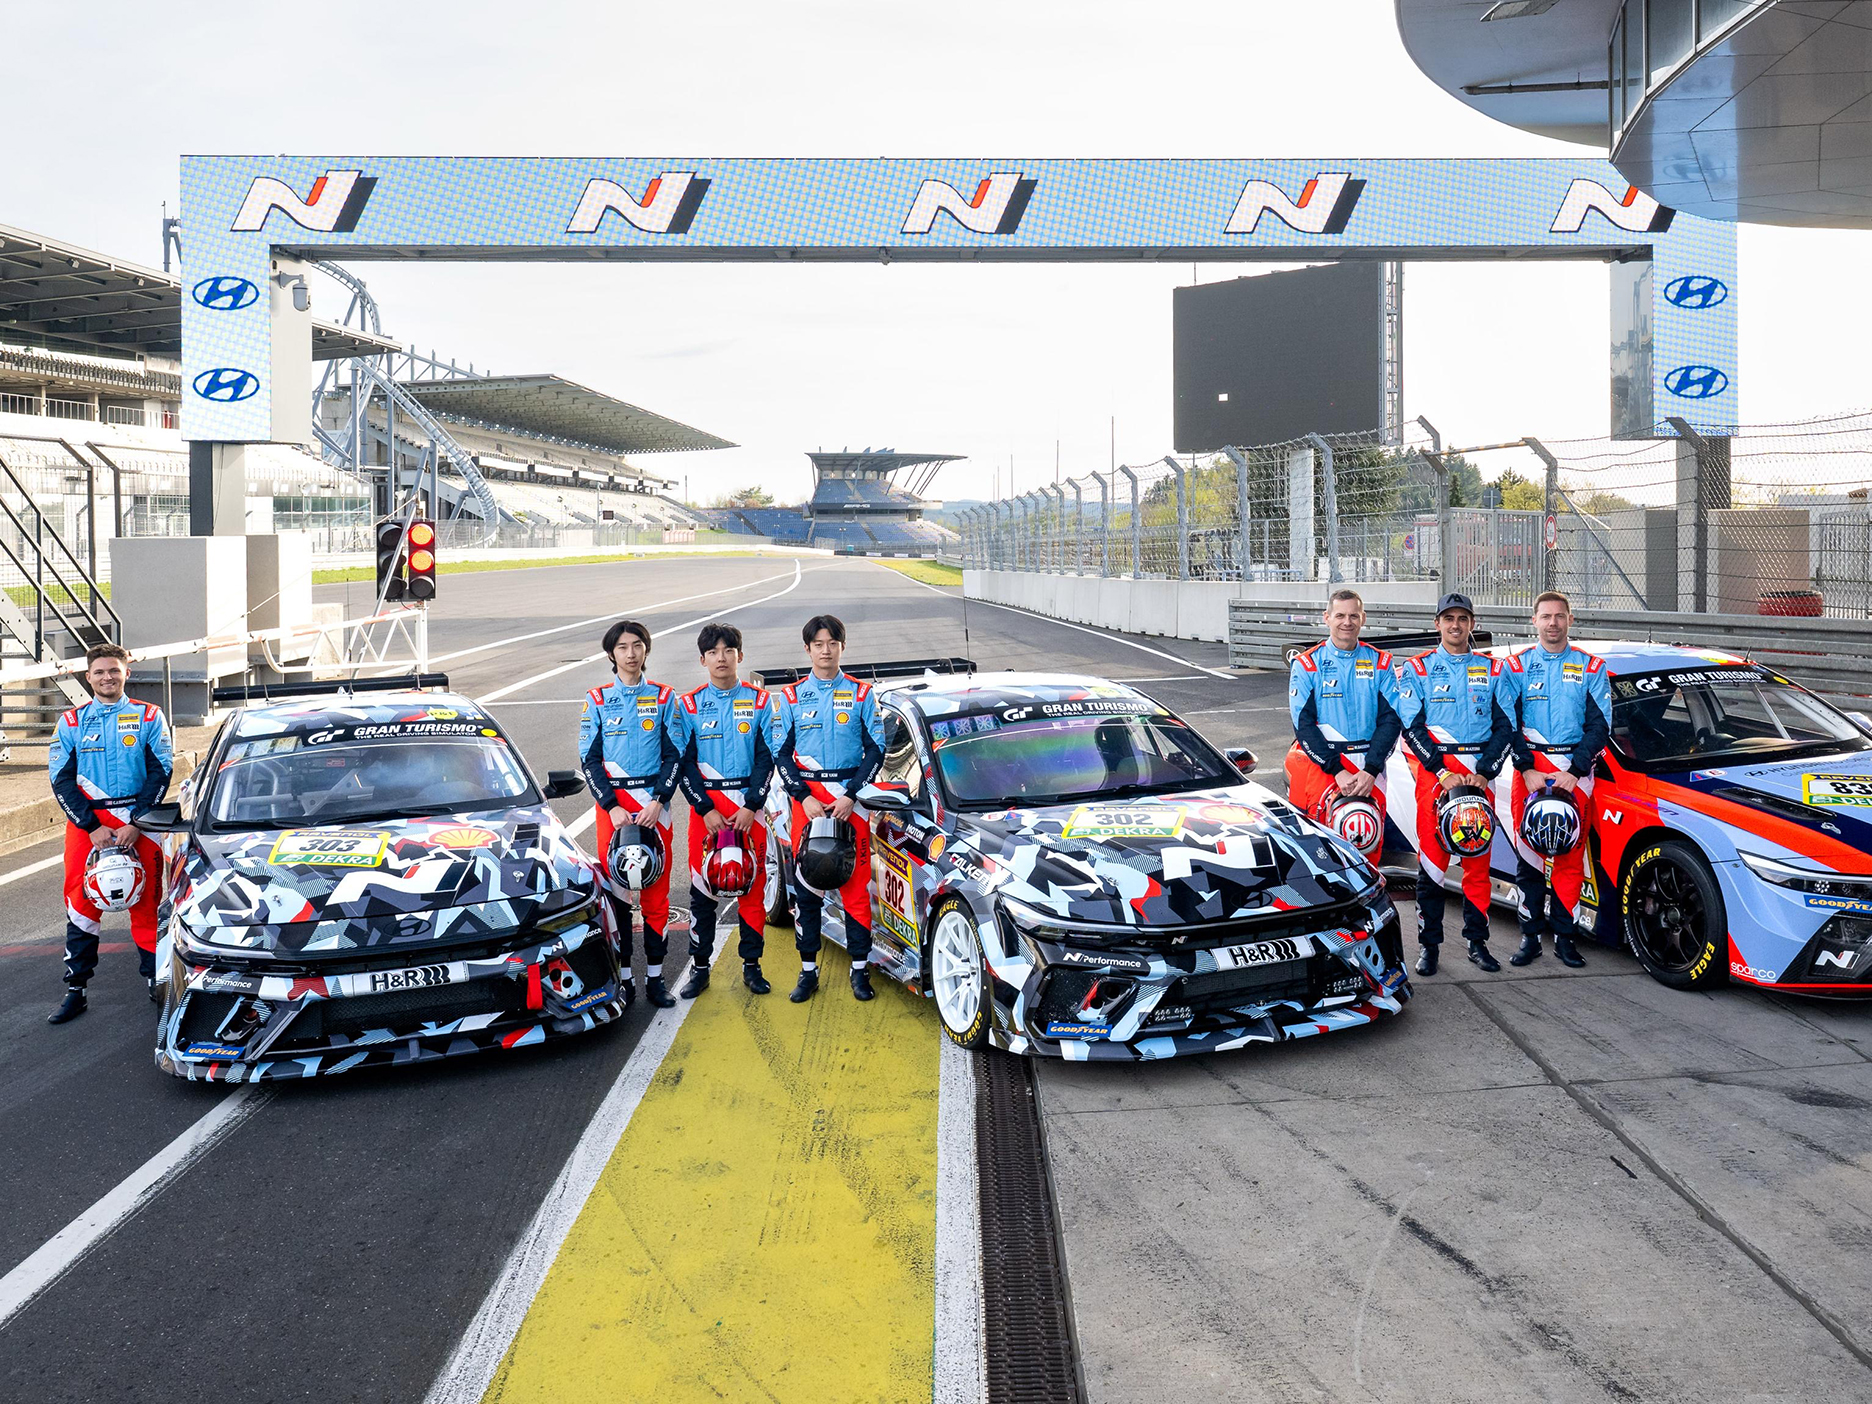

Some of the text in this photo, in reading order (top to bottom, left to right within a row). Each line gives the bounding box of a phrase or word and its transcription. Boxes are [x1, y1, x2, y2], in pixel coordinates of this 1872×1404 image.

[1668, 671, 1762, 684] GRAN TURISMO
[1042, 702, 1148, 714] GRAN TURISMO
[354, 723, 477, 736] GRAN TURISMO
[1413, 738, 1431, 759] HYUNDAI
[1095, 813, 1154, 825] 302
[1602, 809, 1624, 825] N
[906, 824, 925, 841] MOTON
[299, 839, 361, 852] 303
[859, 838, 867, 867] Y.Kim
[308, 854, 373, 865] DEKRA
[1622, 848, 1661, 915] GOODYEAR
[885, 870, 905, 915] 302
[939, 900, 959, 917] EAGLE
[564, 927, 602, 947] Performance
[894, 916, 918, 948] DEKRA
[1084, 955, 1141, 968] Performance
[1690, 941, 1716, 980] EAGLE
[1731, 961, 1776, 979] sparco
[203, 974, 252, 989] Performance
[571, 991, 607, 1010] GOODYEAR
[1050, 1026, 1108, 1035] GOODYEAR
[188, 1047, 240, 1056] GOODYEAR
